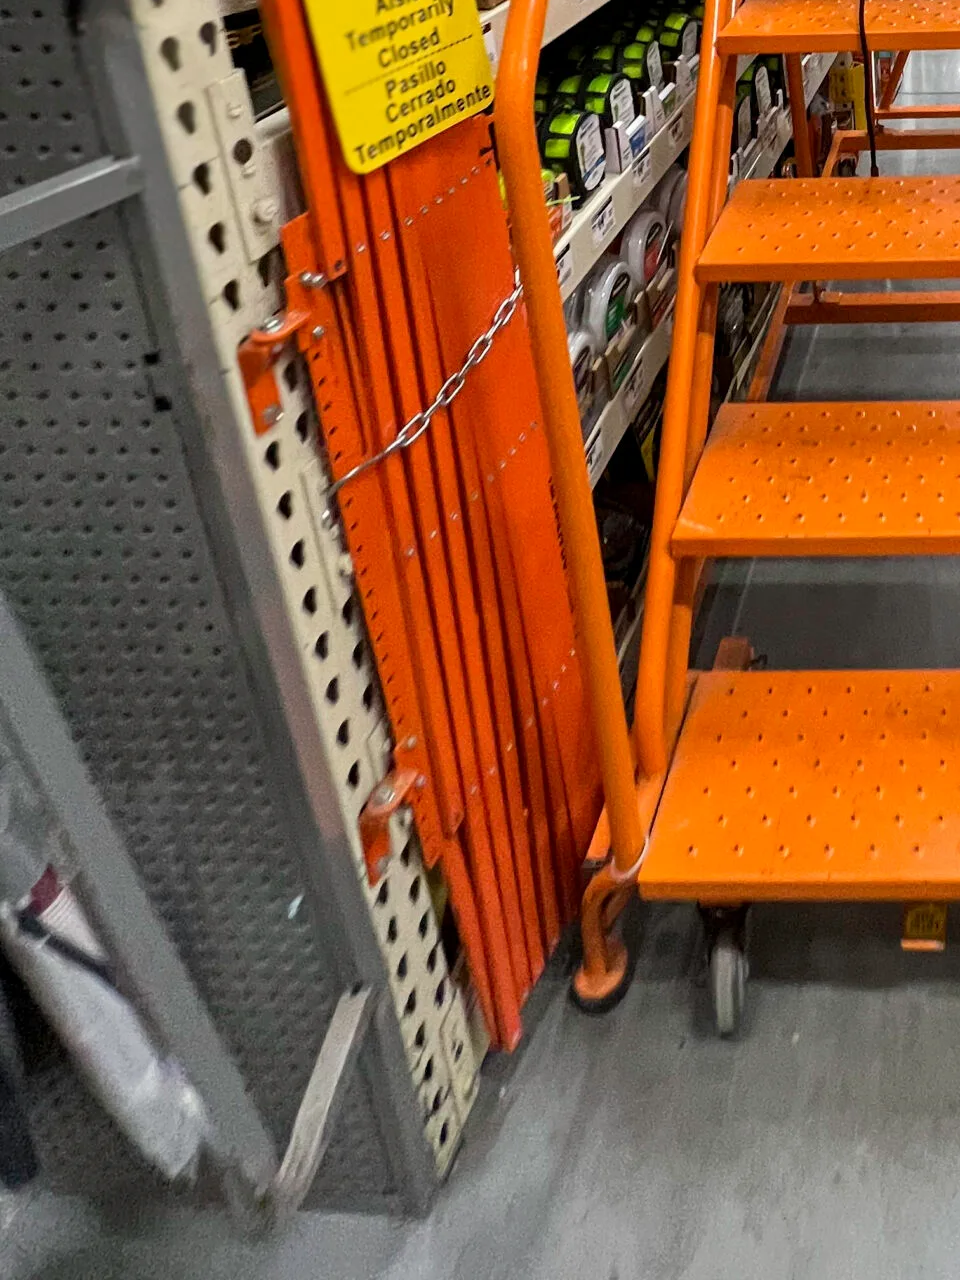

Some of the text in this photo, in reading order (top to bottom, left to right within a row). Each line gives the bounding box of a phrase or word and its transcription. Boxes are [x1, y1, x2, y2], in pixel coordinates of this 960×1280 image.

[377, 26, 440, 68] Closed
[384, 60, 447, 99] Pasillo
[384, 78, 457, 123] Cerrado
[352, 83, 492, 165] Temporalmente
